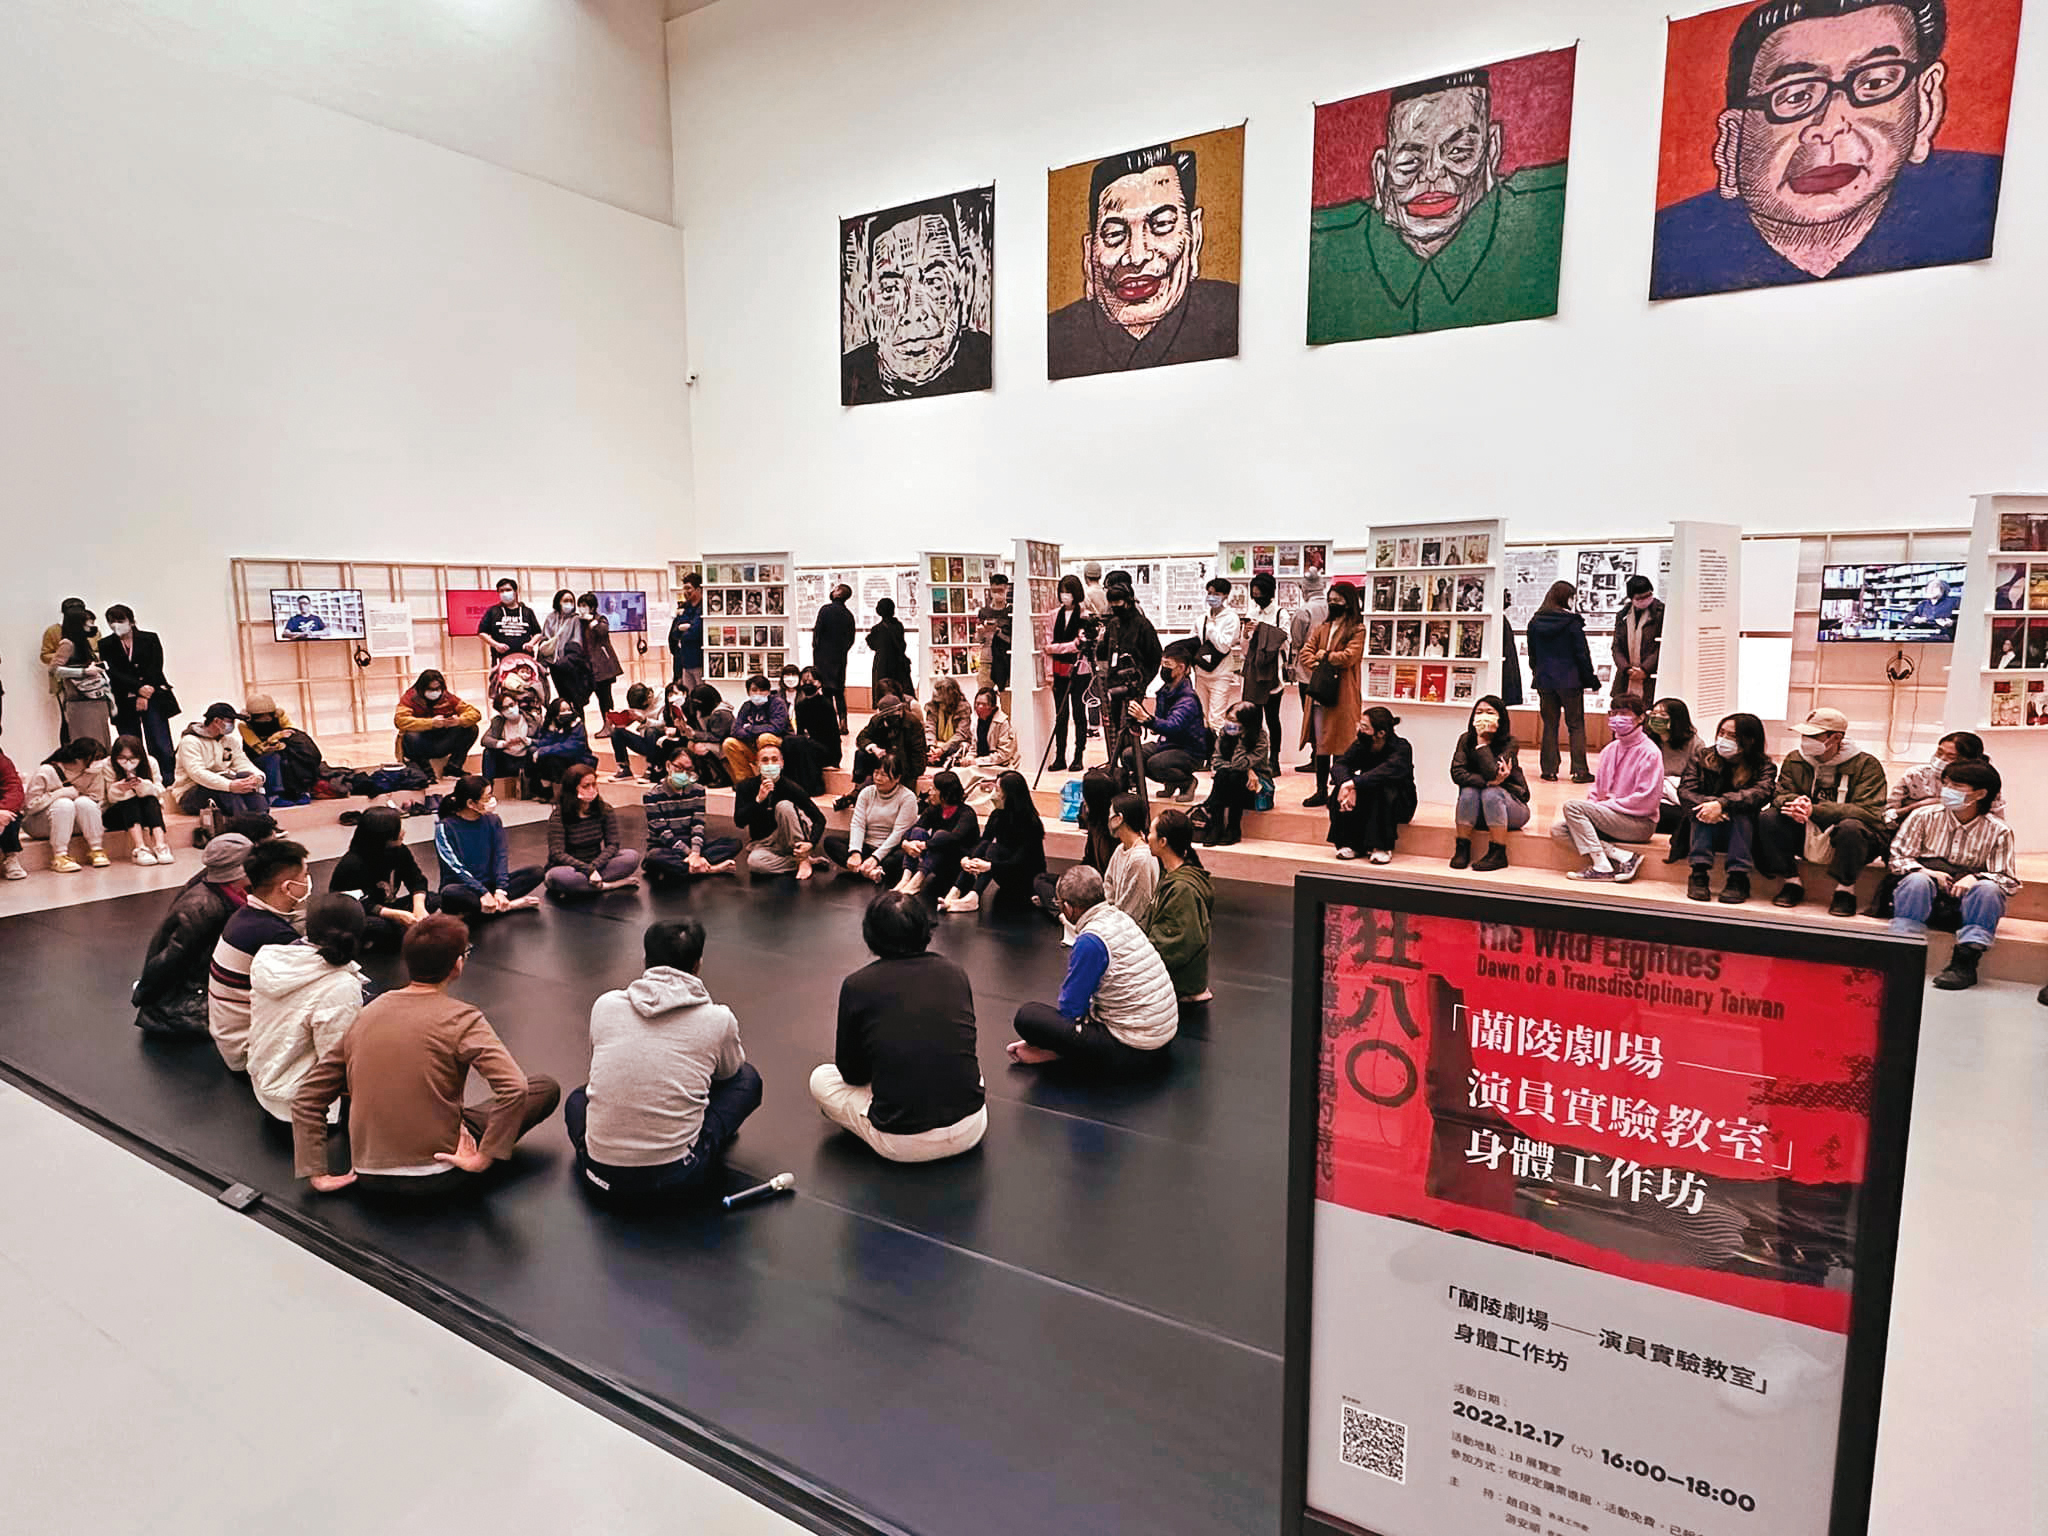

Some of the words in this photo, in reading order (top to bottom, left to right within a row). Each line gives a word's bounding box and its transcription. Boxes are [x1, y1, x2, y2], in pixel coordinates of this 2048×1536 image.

[1477, 954, 1520, 981] Dawn
[1525, 965, 1544, 984] of
[1546, 972, 1556, 987] a
[1562, 965, 1714, 1014] Transdisciplinary
[1720, 987, 1785, 1020] Taiwan
[1464, 1128, 1709, 1215] 身體工作坊
[1454, 1323, 1569, 1372] 身體工作坊
[1453, 1401, 1565, 1448] 2022.12.17
